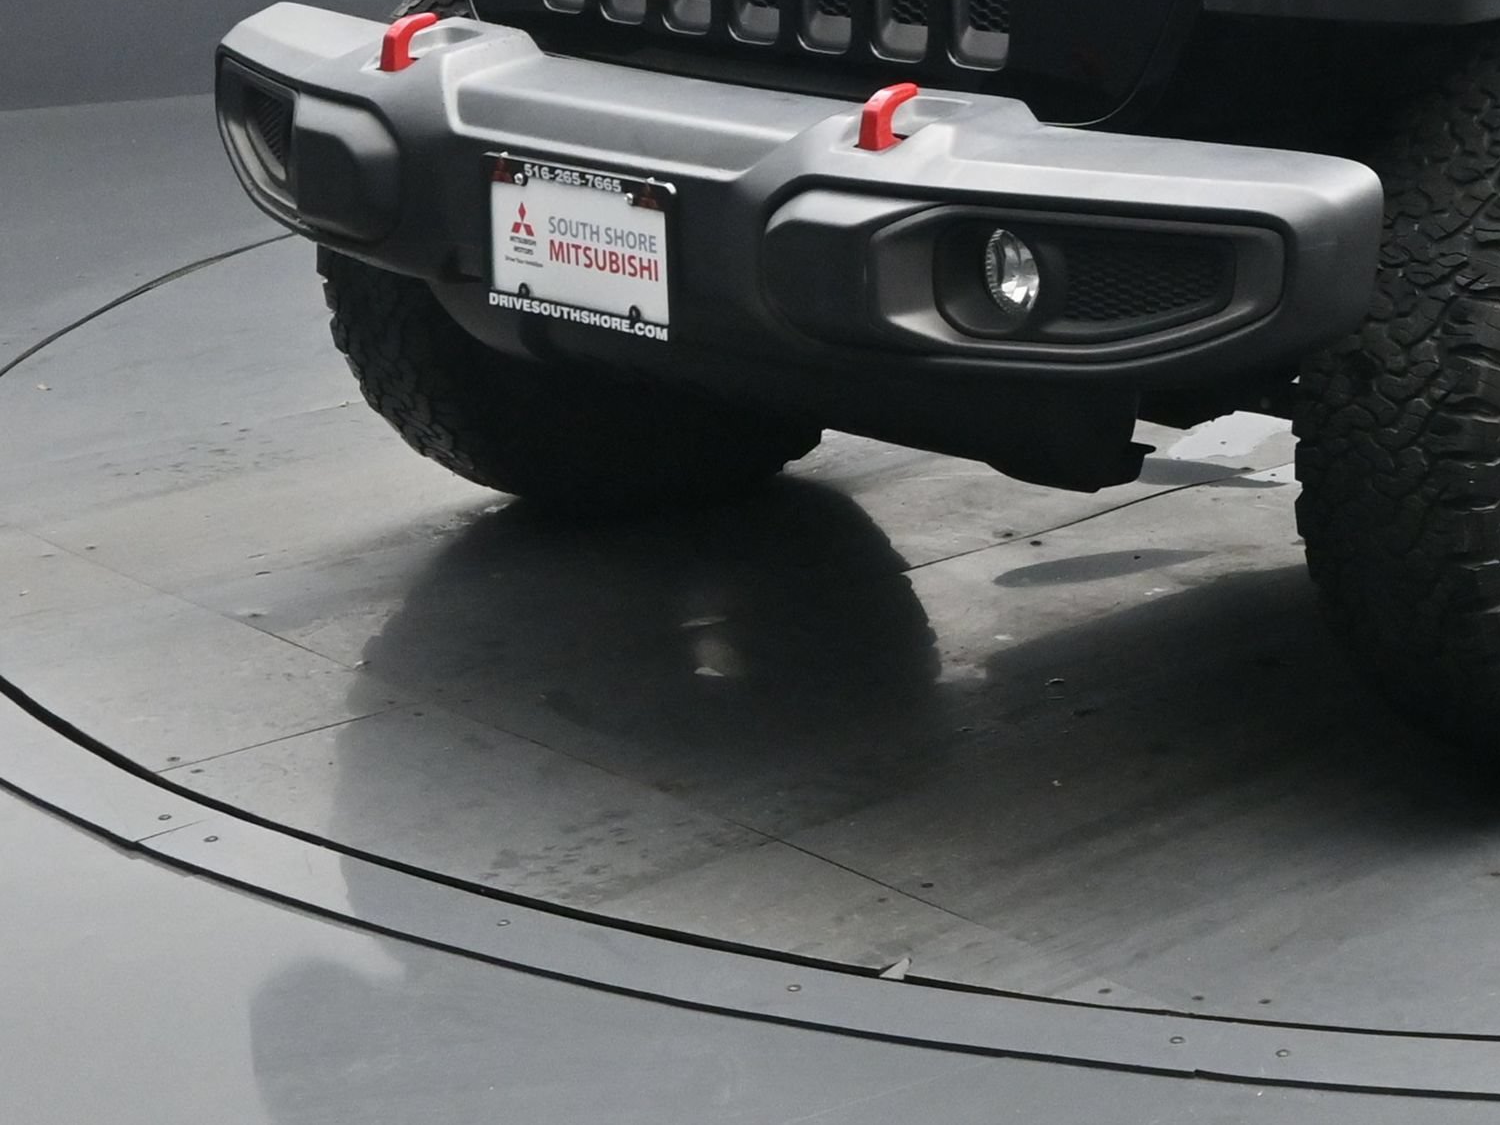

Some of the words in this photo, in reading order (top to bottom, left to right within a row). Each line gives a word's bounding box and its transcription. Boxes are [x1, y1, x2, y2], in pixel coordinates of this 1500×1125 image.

[524, 163, 622, 193] 516-265-7665
[548, 216, 600, 243] SOUTH
[605, 227, 657, 253] SHORE
[549, 239, 659, 282] MITSUBISHI
[489, 291, 668, 341] DRIVESOUTHSHORE.COM
